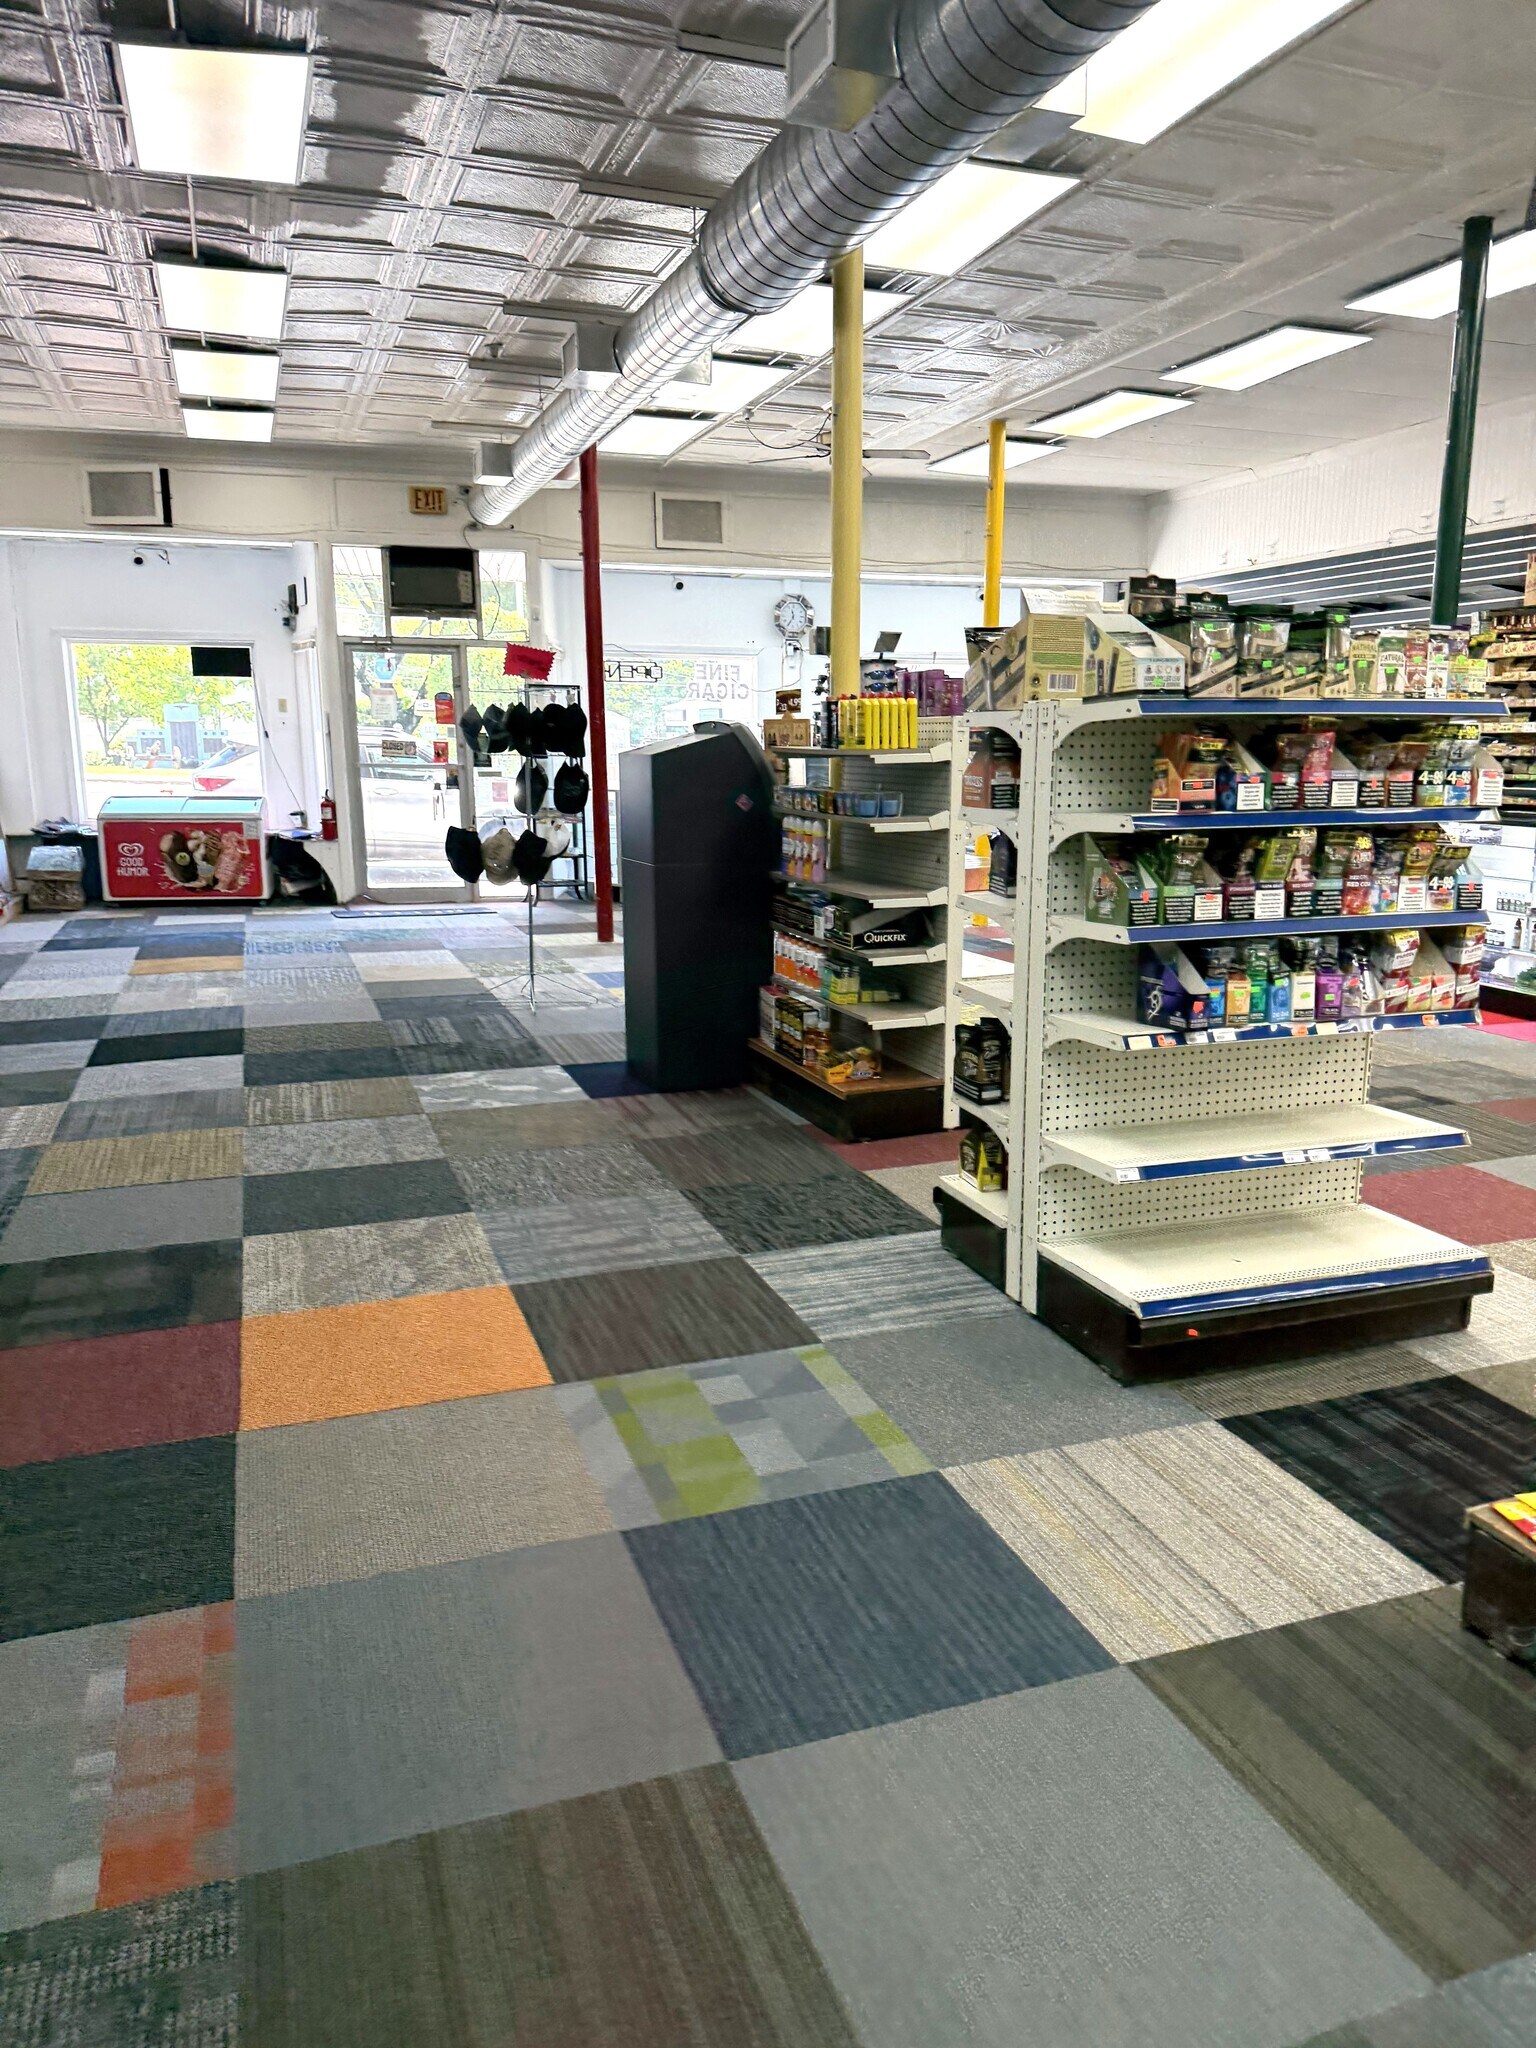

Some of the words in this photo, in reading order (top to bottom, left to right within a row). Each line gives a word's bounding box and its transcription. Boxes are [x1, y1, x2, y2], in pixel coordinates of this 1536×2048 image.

[415, 489, 443, 511] EXIT
[382, 741, 404, 751] CLOSED
[120, 857, 143, 866] GOOD
[117, 866, 150, 876] HUMOR
[864, 932, 907, 943] QUICKFIX
